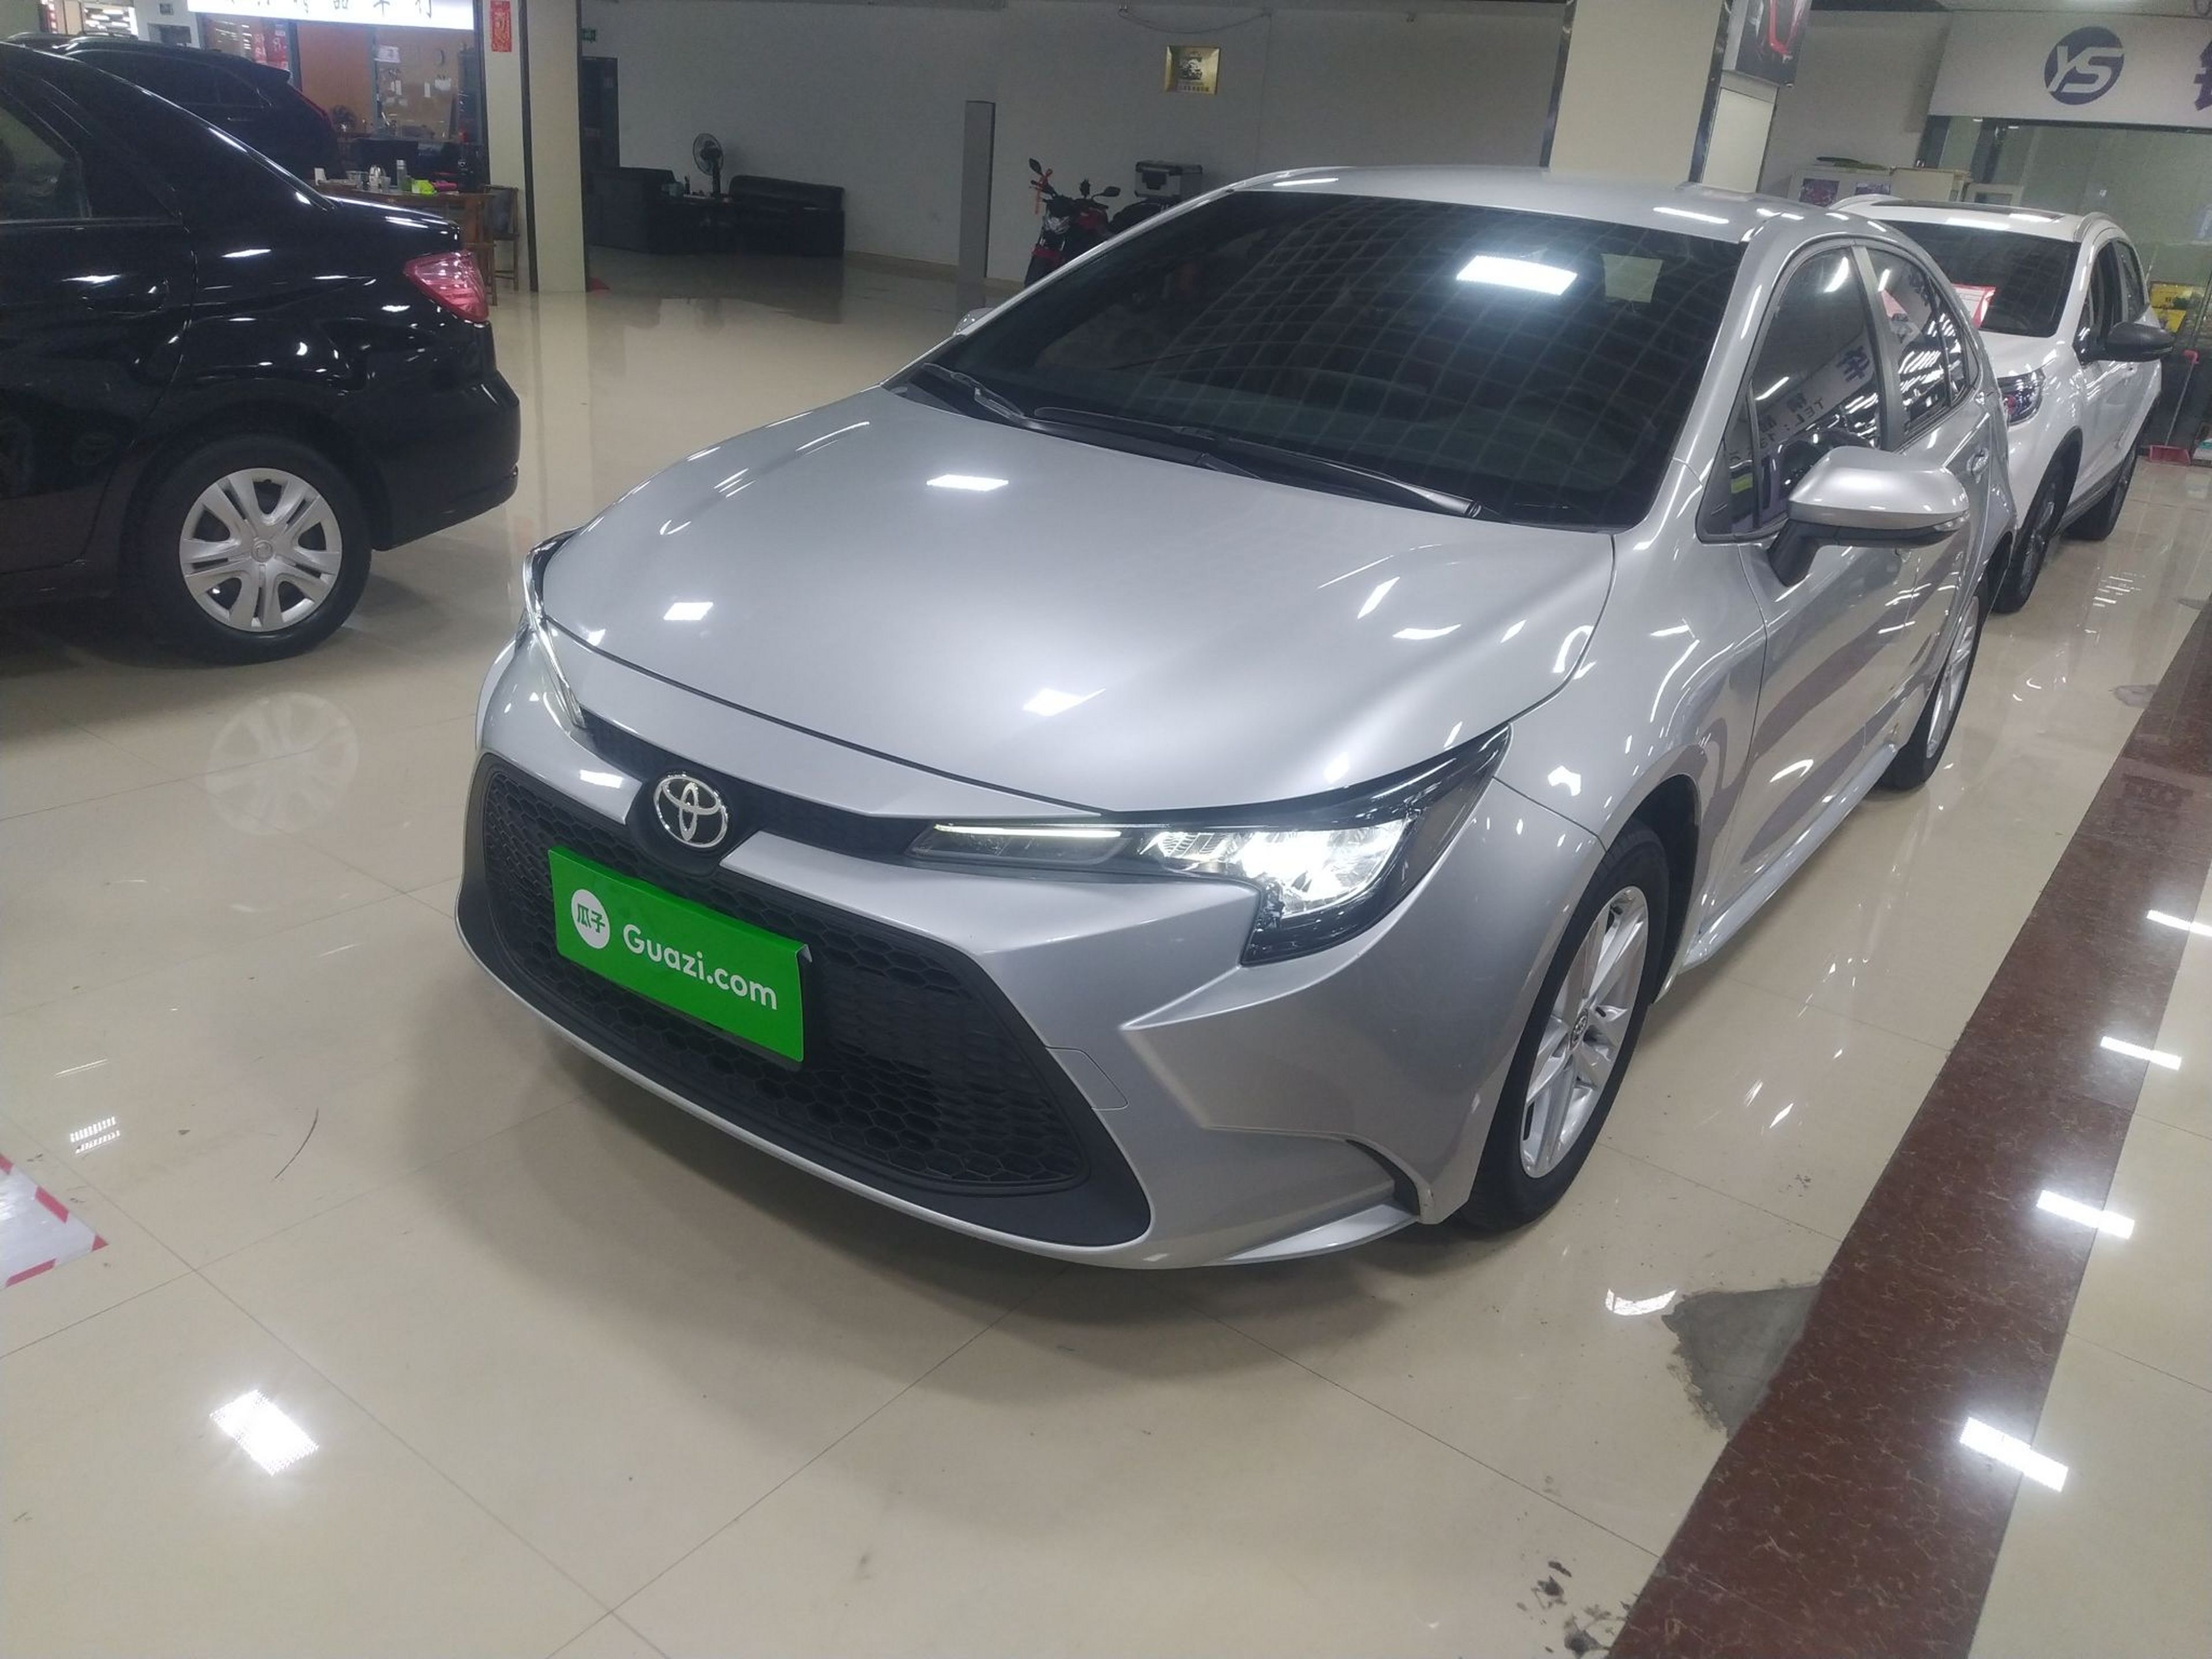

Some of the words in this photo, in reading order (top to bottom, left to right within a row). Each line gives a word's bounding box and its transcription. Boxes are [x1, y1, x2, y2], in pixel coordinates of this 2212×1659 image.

[2047, 46, 2124, 93] YS
[577, 903, 605, 933] 瓜子
[623, 924, 777, 1010] Guazi.com
